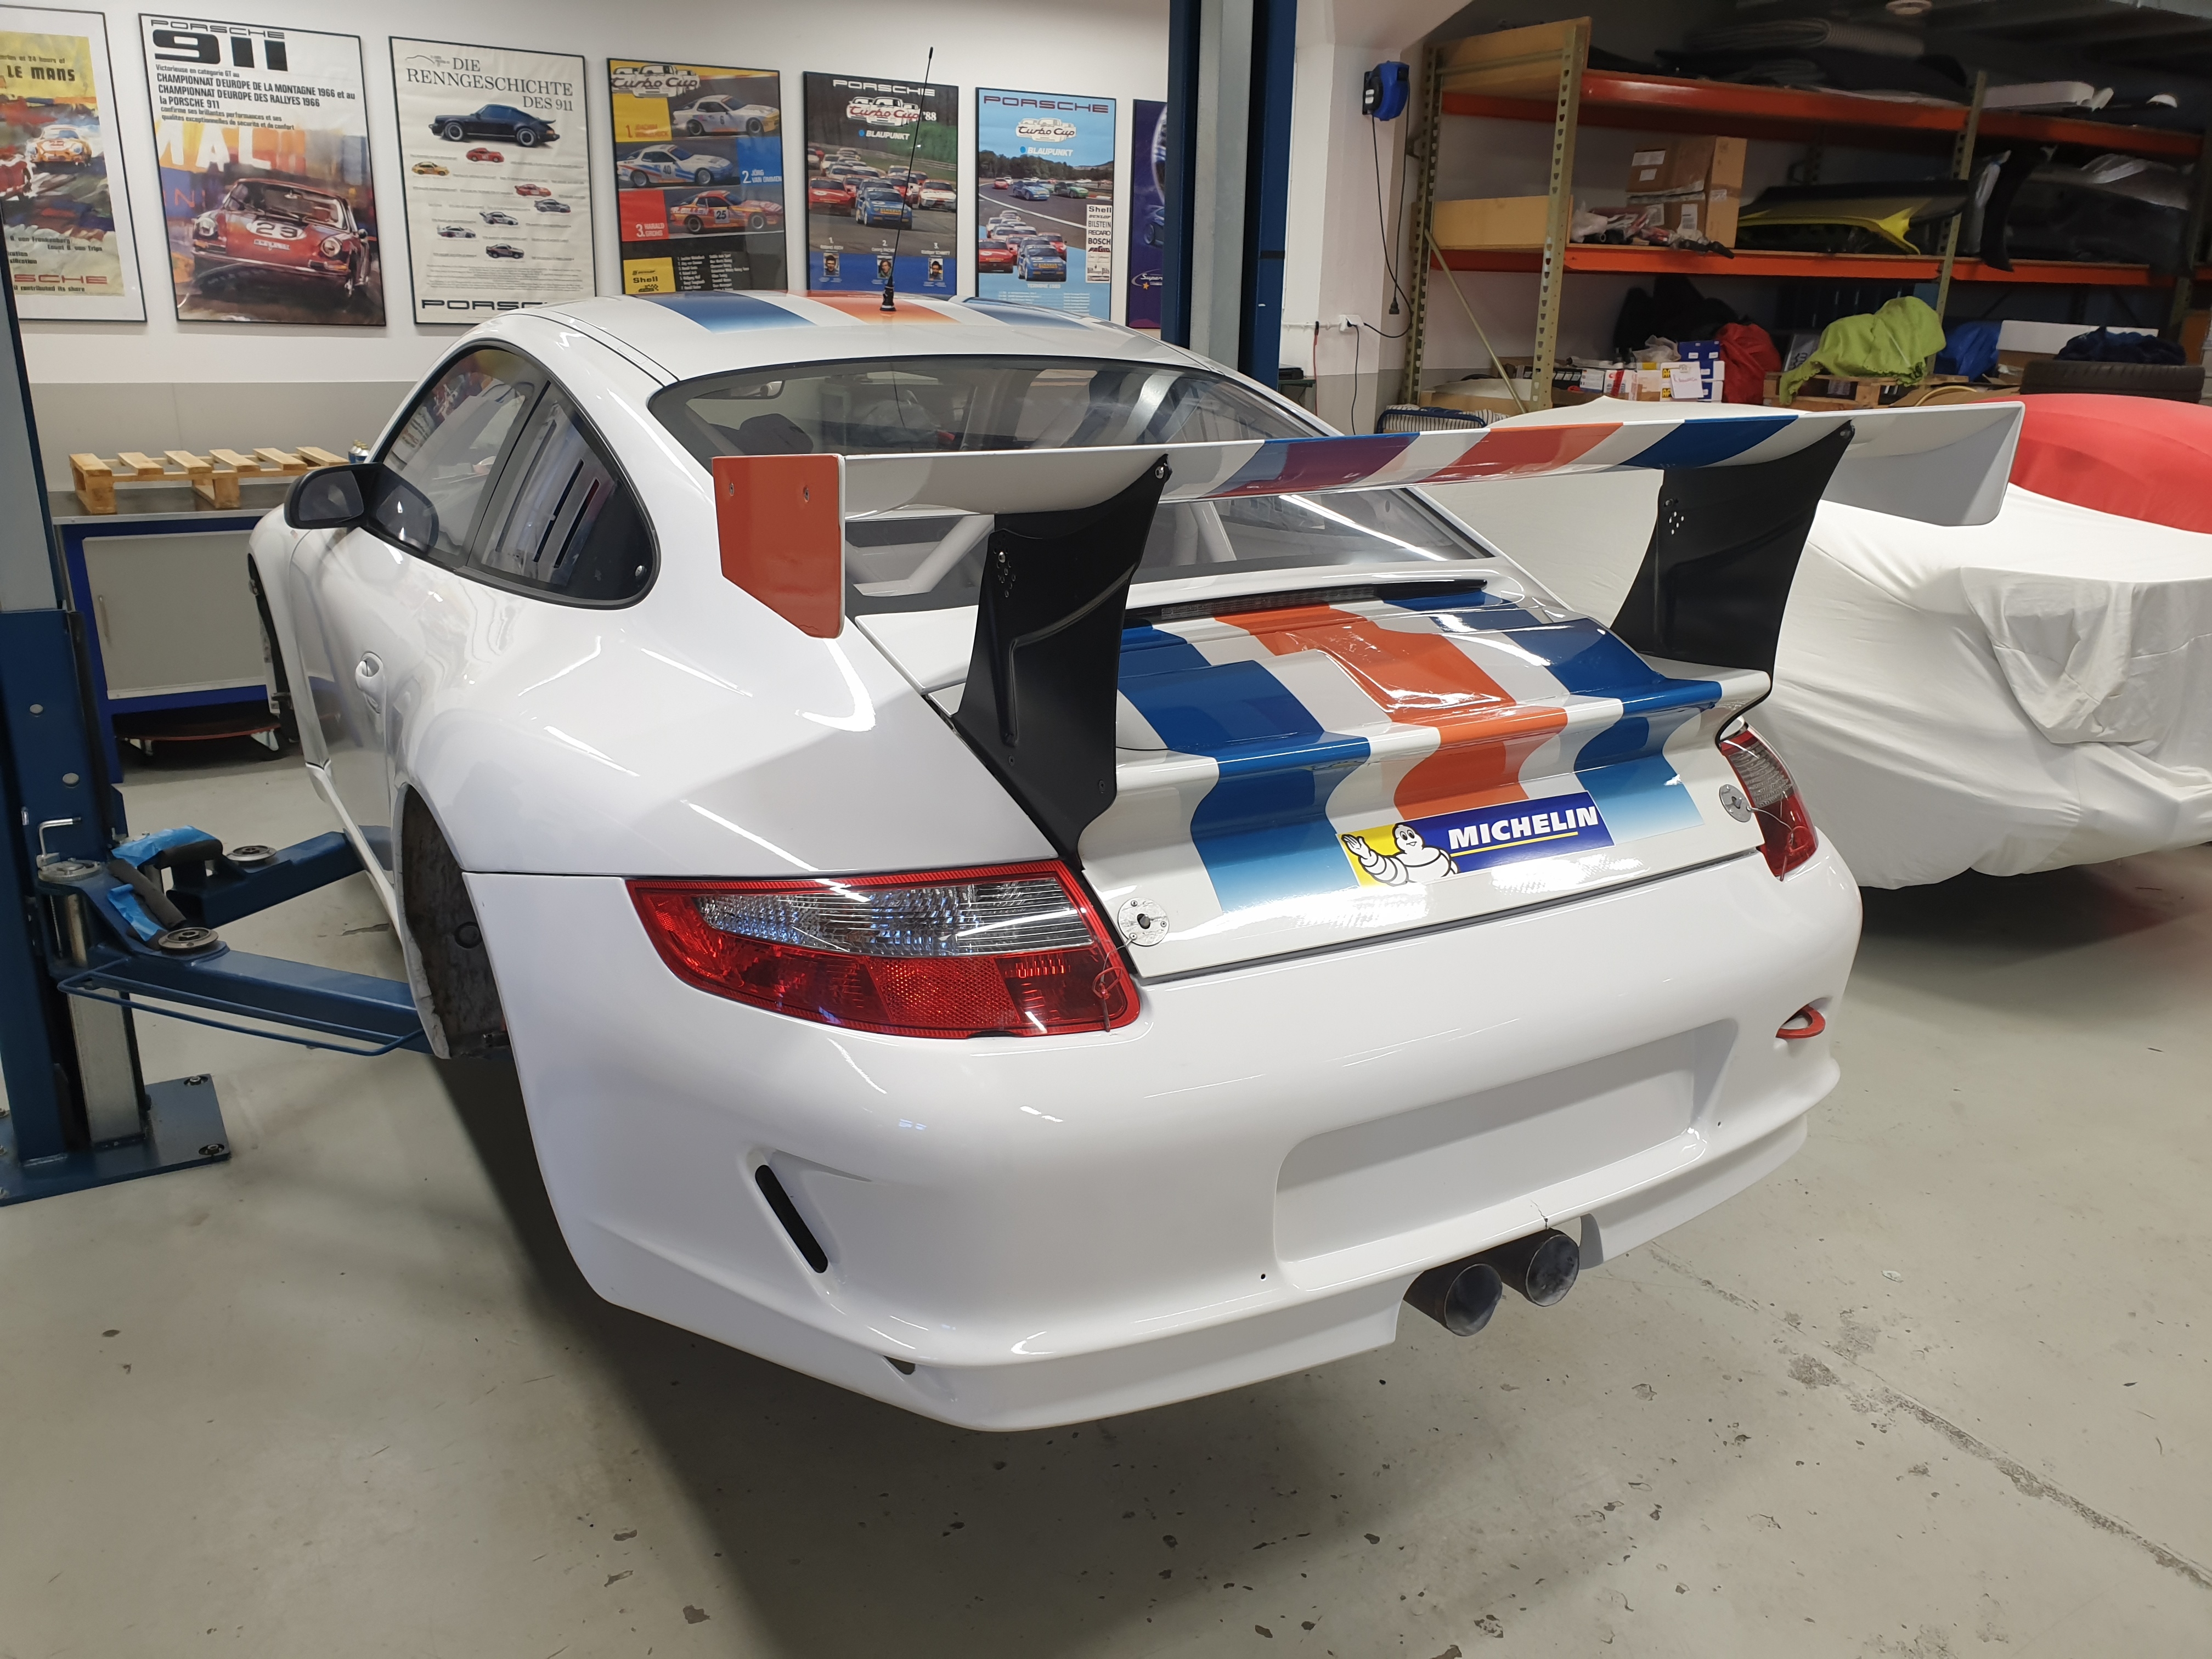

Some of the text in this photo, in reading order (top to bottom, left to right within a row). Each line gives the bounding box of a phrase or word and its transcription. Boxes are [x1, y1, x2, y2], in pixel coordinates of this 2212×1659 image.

[151, 20, 285, 38] PORSCHE
[153, 29, 288, 71] 911
[156, 64, 188, 73] Victorieuse
[452, 57, 481, 72] DIE
[7, 65, 22, 78] LE
[157, 73, 213, 86] CHAMPIONNAT
[252, 82, 262, 91] DE
[264, 83, 273, 92] LA
[274, 84, 316, 96] MONTAGNE
[318, 88, 335, 98] 1966
[406, 68, 573, 97] RENNGESCHICHTE
[665, 77, 697, 89] Cup
[833, 79, 935, 97] PORSCHE
[158, 84, 215, 98] CHAMPIONNAT
[254, 93, 268, 103] DES
[270, 94, 301, 105] RALLYES
[302, 97, 320, 107] 1966
[160, 95, 220, 109] la PORSCHE 911
[522, 95, 573, 111] DES 911
[984, 95, 1109, 114] PORSCHE
[226, 111, 264, 120] performances
[894, 110, 920, 121] Cup
[922, 111, 936, 121] '88
[866, 130, 910, 140] BLAUPUNKT
[1054, 128, 1075, 137] Cup
[1028, 146, 1073, 156] BLAUPUNKT
[663, 166, 672, 175] 40
[716, 211, 726, 219] 25
[14, 274, 108, 285] SCHE
[1448, 805, 1599, 850] MICHELIN
